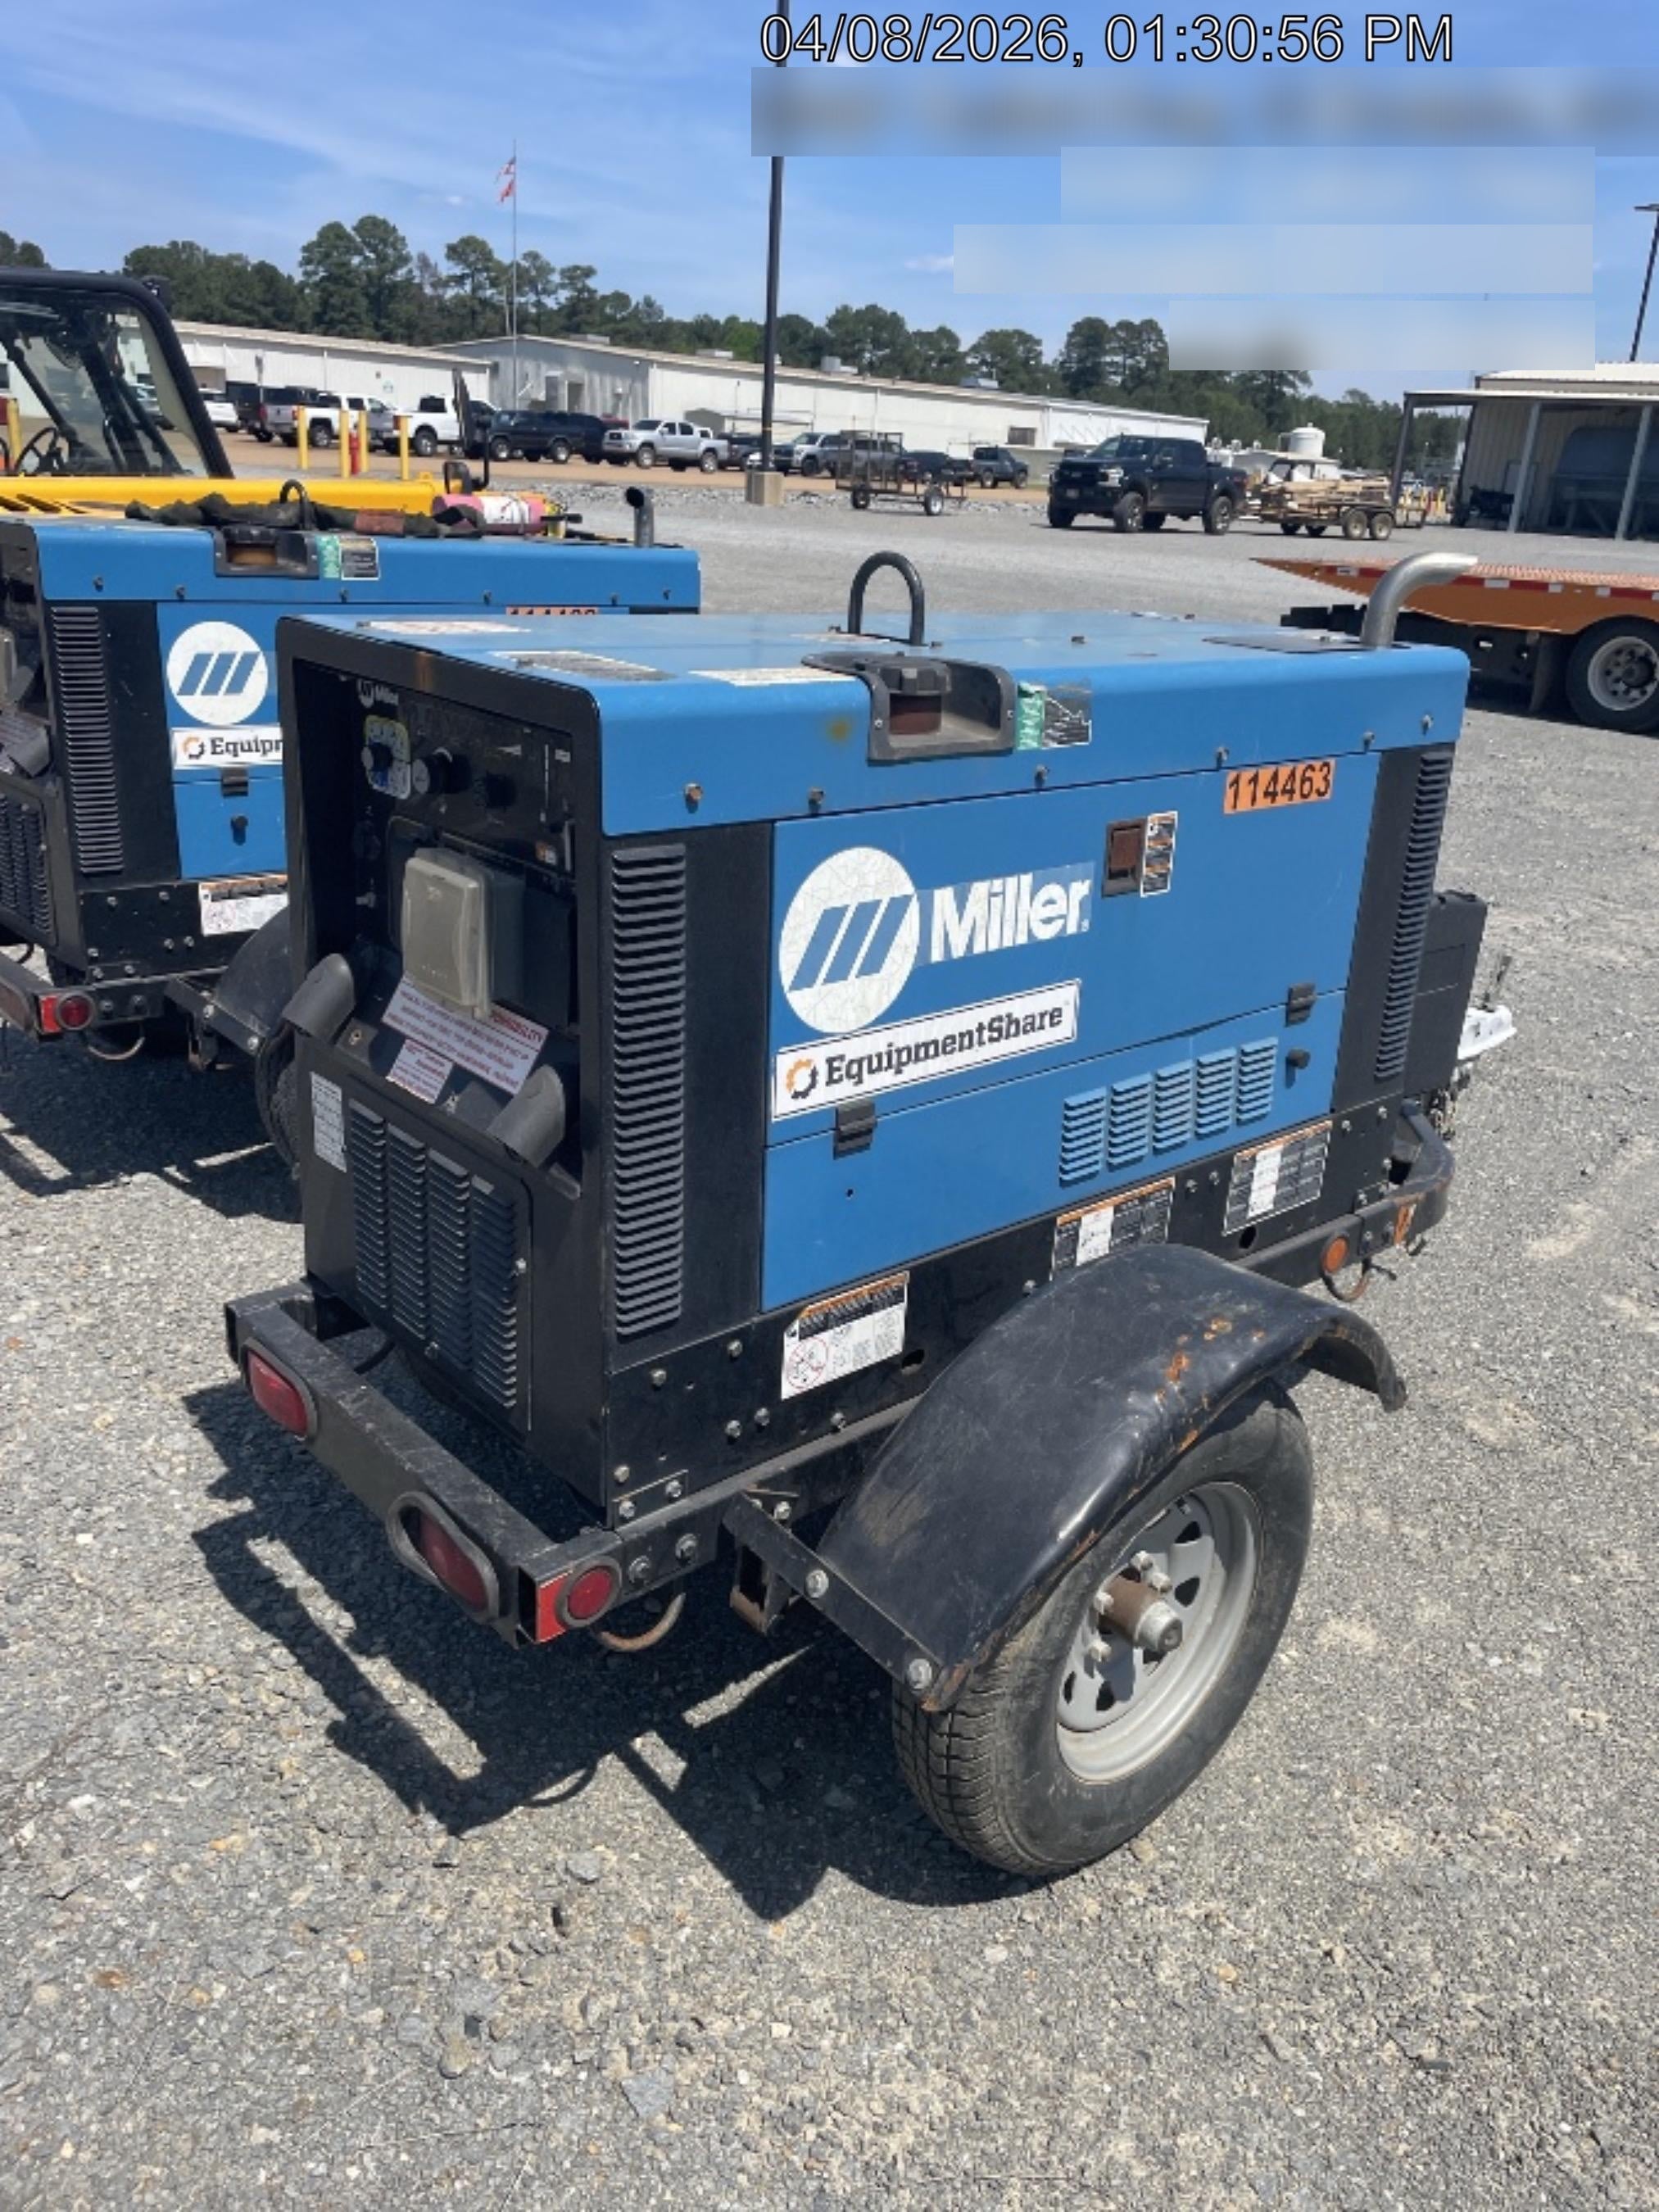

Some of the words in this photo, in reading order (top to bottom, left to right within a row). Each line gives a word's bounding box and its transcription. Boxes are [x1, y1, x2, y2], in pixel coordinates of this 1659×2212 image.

[1228, 760, 1332, 810] 114463
[929, 872, 1092, 963] Miller
[825, 1007, 1063, 1087] EquipmentShare
